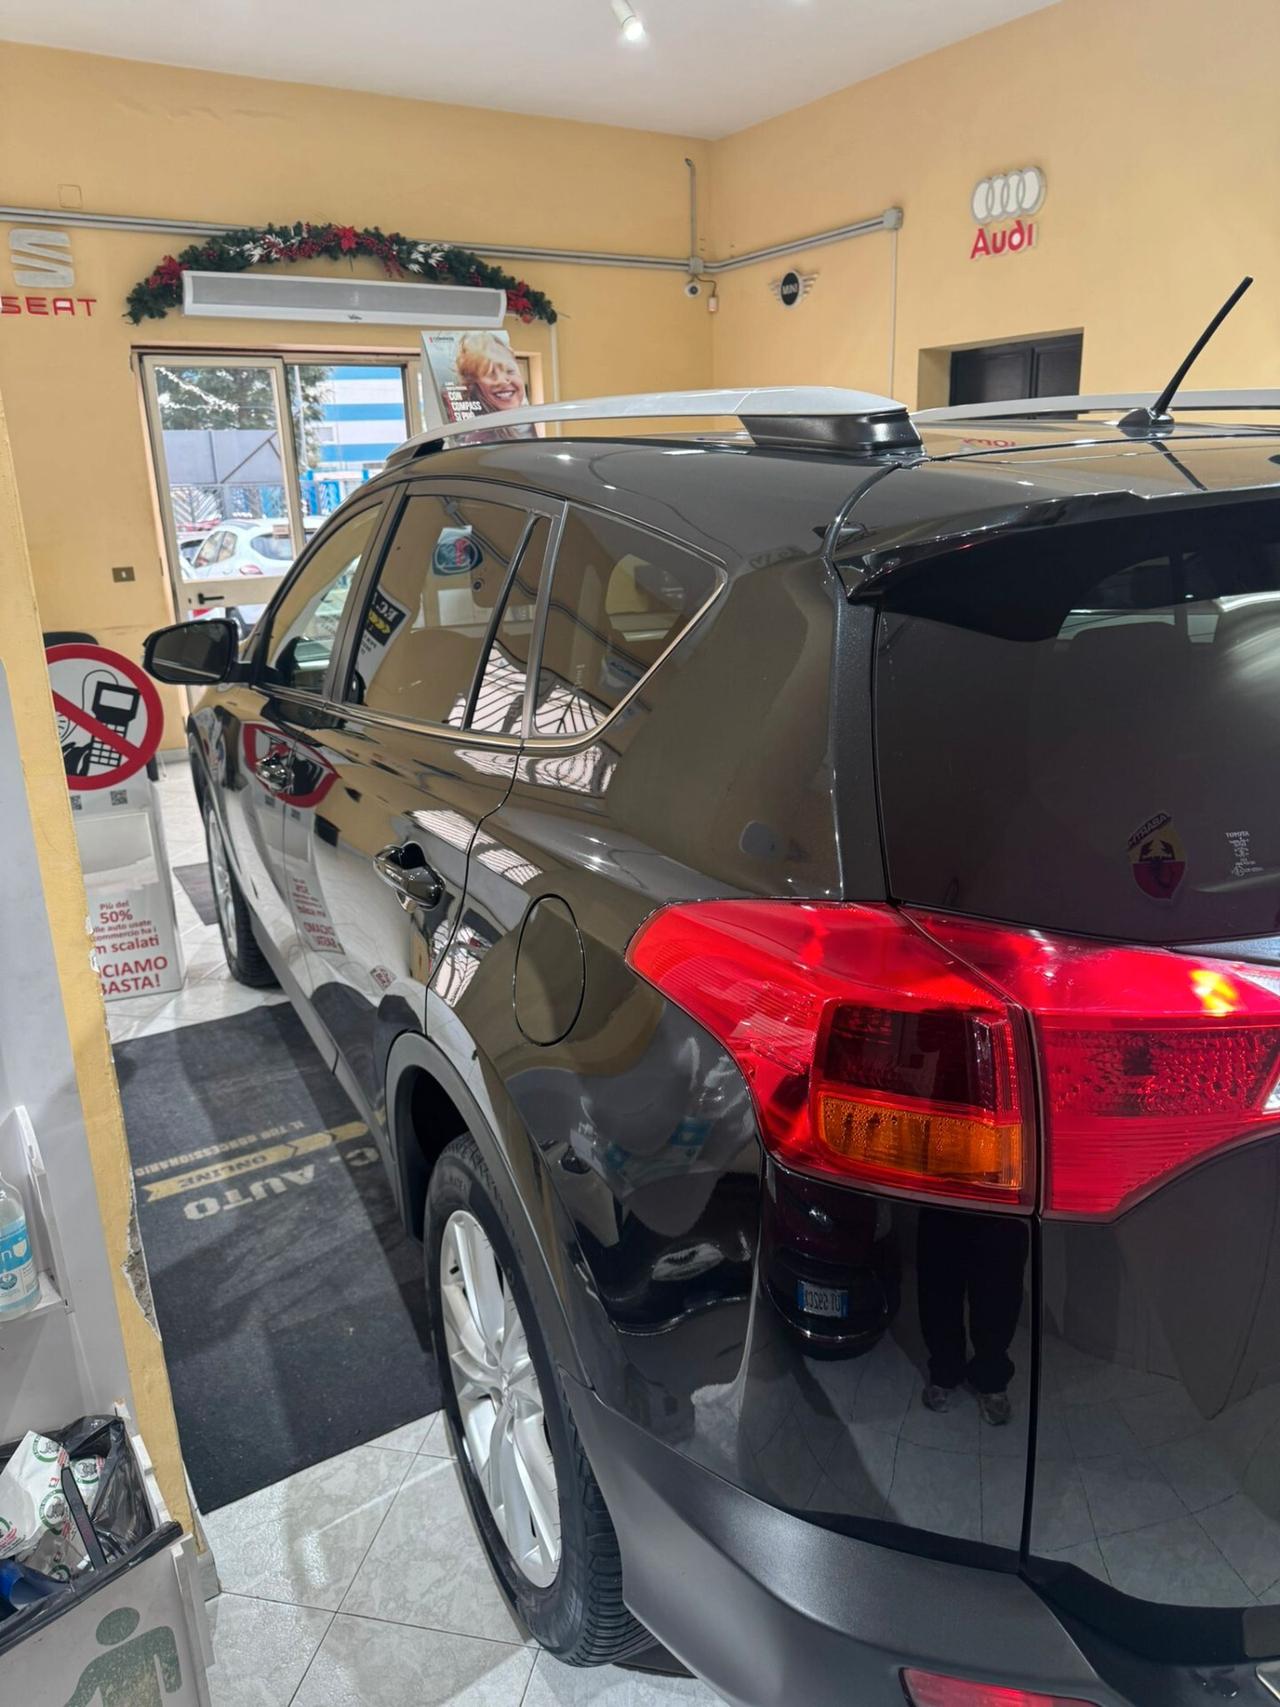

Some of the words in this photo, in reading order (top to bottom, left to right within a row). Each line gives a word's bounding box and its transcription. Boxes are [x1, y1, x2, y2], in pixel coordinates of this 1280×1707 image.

[970, 219, 1034, 259] Audi
[782, 283, 799, 295] MINI
[1, 296, 97, 316] SEAT
[448, 390, 463, 401] CON
[451, 400, 482, 411] COMPASS
[100, 909, 133, 924] 50%
[96, 929, 140, 941] ommercio
[96, 945, 107, 955] m
[111, 934, 160, 953] scalati
[100, 956, 168, 978] CIAMO
[177, 1155, 267, 1187] ONLINE
[183, 1163, 315, 1221] AUTO
